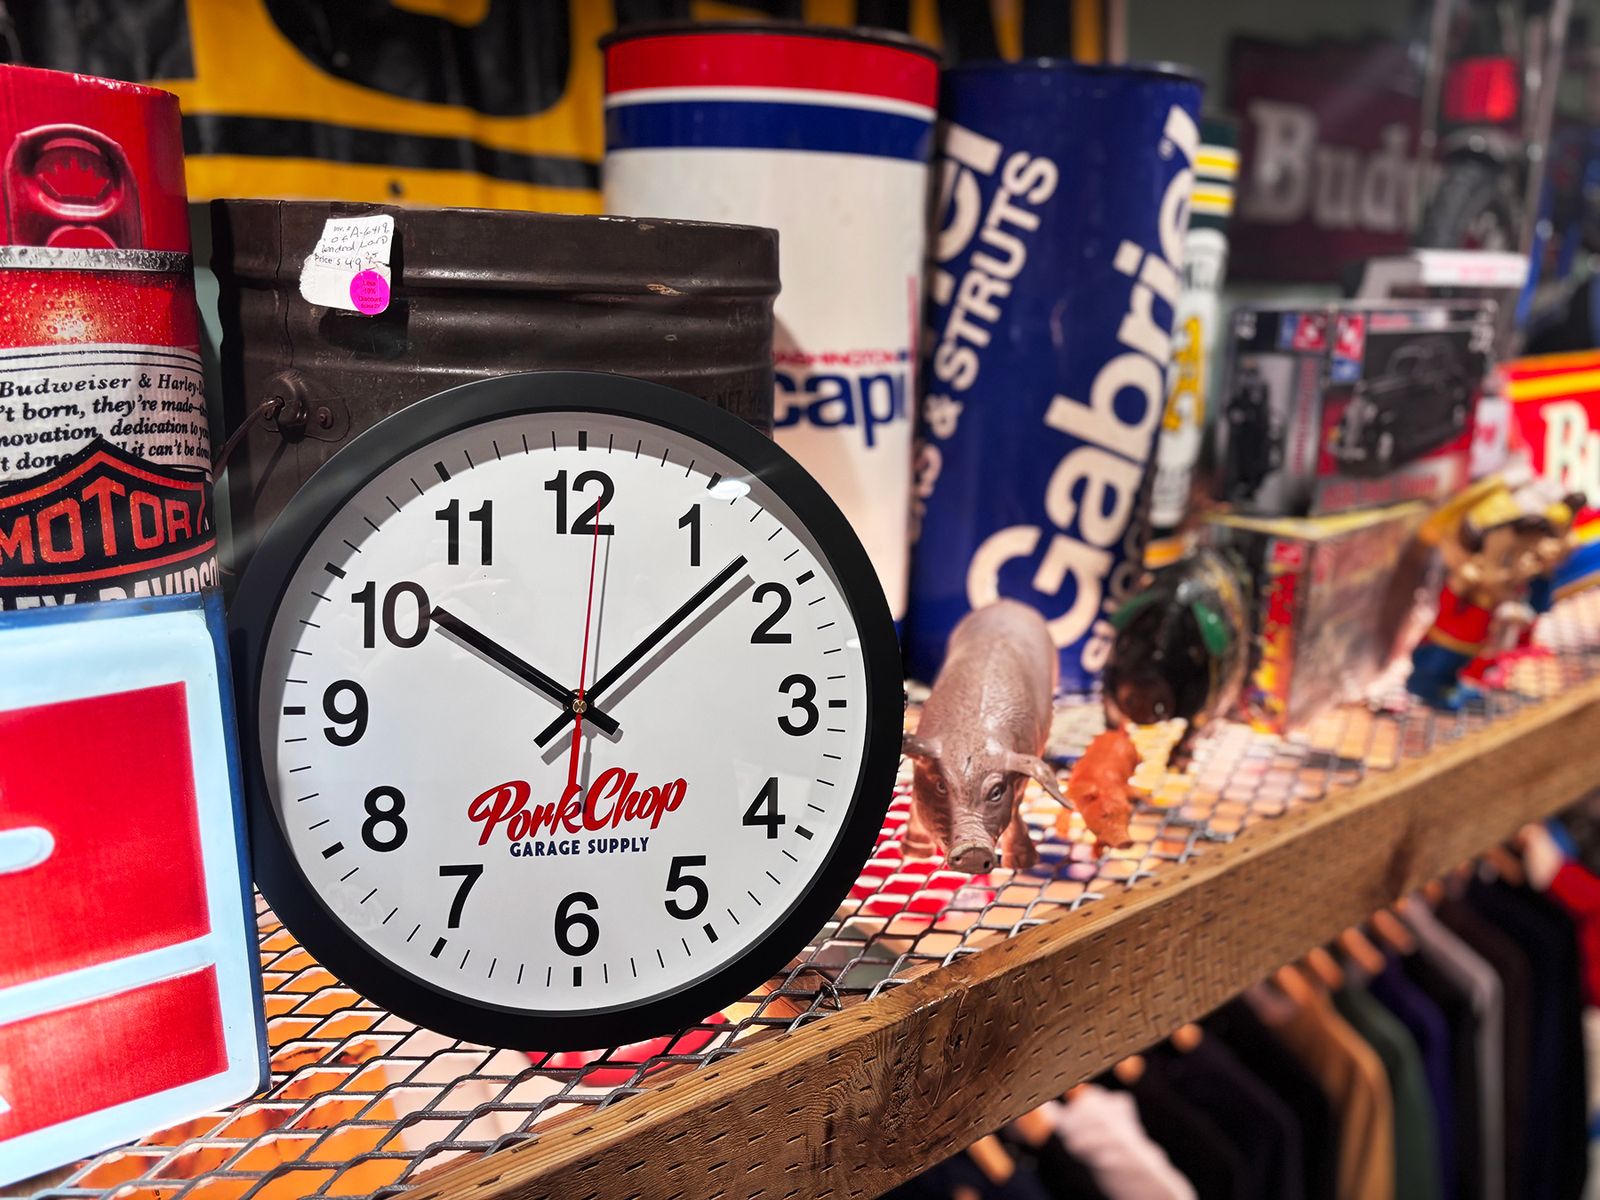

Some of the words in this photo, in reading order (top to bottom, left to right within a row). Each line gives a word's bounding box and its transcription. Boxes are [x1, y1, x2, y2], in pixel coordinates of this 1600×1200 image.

[934, 151, 1059, 392] STRUTS
[0, 374, 131, 398] Budweiser
[138, 373, 152, 388] &
[23, 402, 86, 419] born,
[93, 395, 157, 420] they're
[110, 417, 188, 437] dedication
[190, 421, 199, 436] to
[148, 441, 183, 457] can't
[184, 443, 195, 456] be
[0, 475, 193, 565] MOTOR
[435, 498, 493, 566] 11
[544, 470, 615, 536] 12
[678, 504, 701, 567] 1
[351, 580, 431, 649] 10
[750, 582, 793, 644] 2
[322, 679, 369, 746] 9
[777, 674, 819, 737] 3
[361, 786, 408, 852] 8
[468, 780, 584, 846] Pork
[582, 767, 688, 832] Chop
[742, 777, 786, 839] 4
[510, 840, 580, 857] GARAGE
[588, 837, 650, 854] SUPPLY
[439, 864, 484, 929] 7
[664, 855, 709, 920] 5
[554, 891, 600, 956] 6
